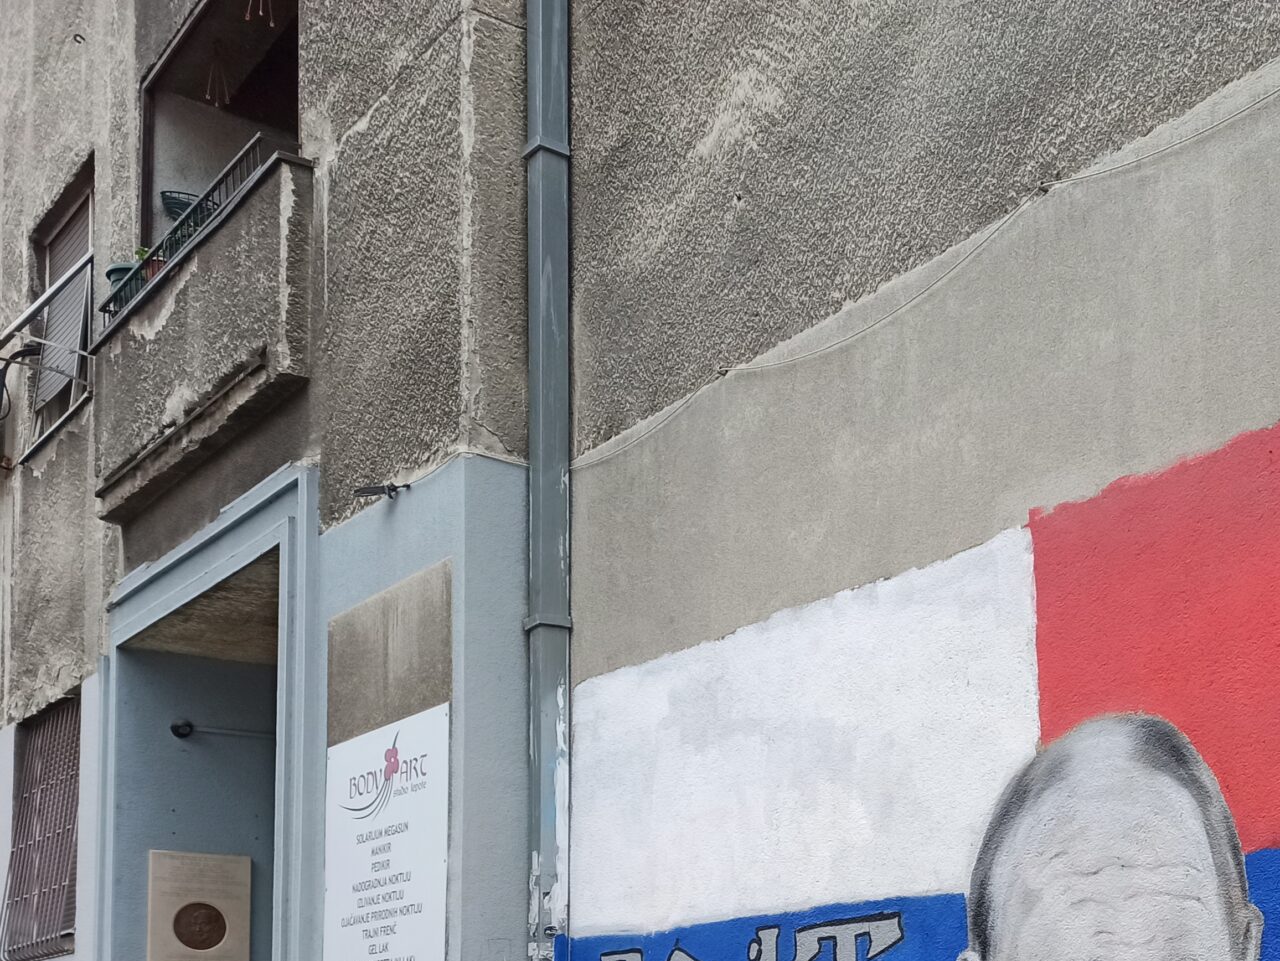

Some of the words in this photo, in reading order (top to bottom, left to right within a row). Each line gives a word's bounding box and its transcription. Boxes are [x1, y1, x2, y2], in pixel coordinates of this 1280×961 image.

[349, 768, 383, 800] BODY
[400, 753, 428, 783] ART
[384, 821, 409, 837] MEGASUN
[352, 878, 387, 893] NADOGRADNJA
[389, 871, 412, 885] NOKTIJU
[382, 889, 405, 903] NOKTIJU
[371, 907, 398, 921] PRIRODNIH
[399, 902, 423, 916] NOKTIJU
[362, 927, 379, 940] TRAJNI
[368, 943, 378, 955] GEL
[379, 942, 389, 954] LAK
